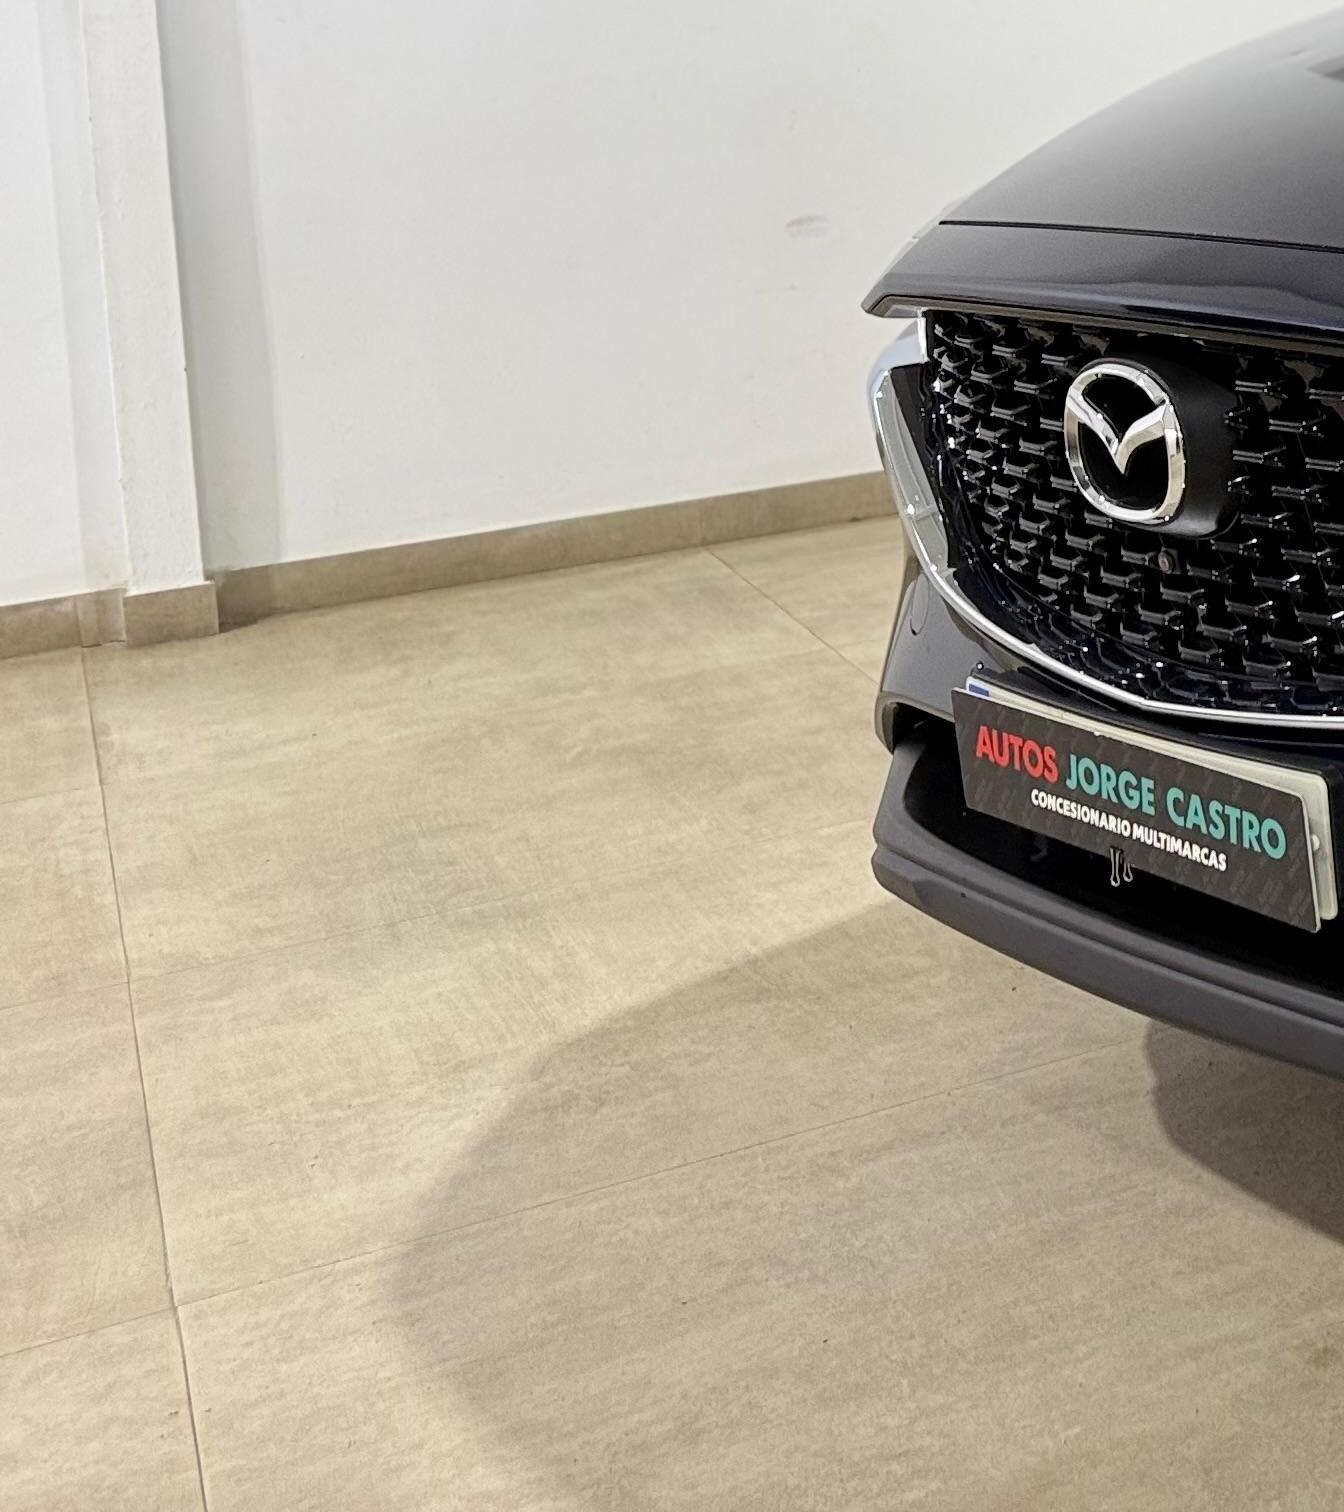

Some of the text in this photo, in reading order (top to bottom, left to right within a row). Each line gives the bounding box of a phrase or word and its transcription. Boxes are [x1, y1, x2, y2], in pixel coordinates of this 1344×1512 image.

[975, 724, 1288, 861] AUTOS JORGE CASTRO
[1030, 788, 1228, 873] CONCESIONARIO MULTIMARCAS
